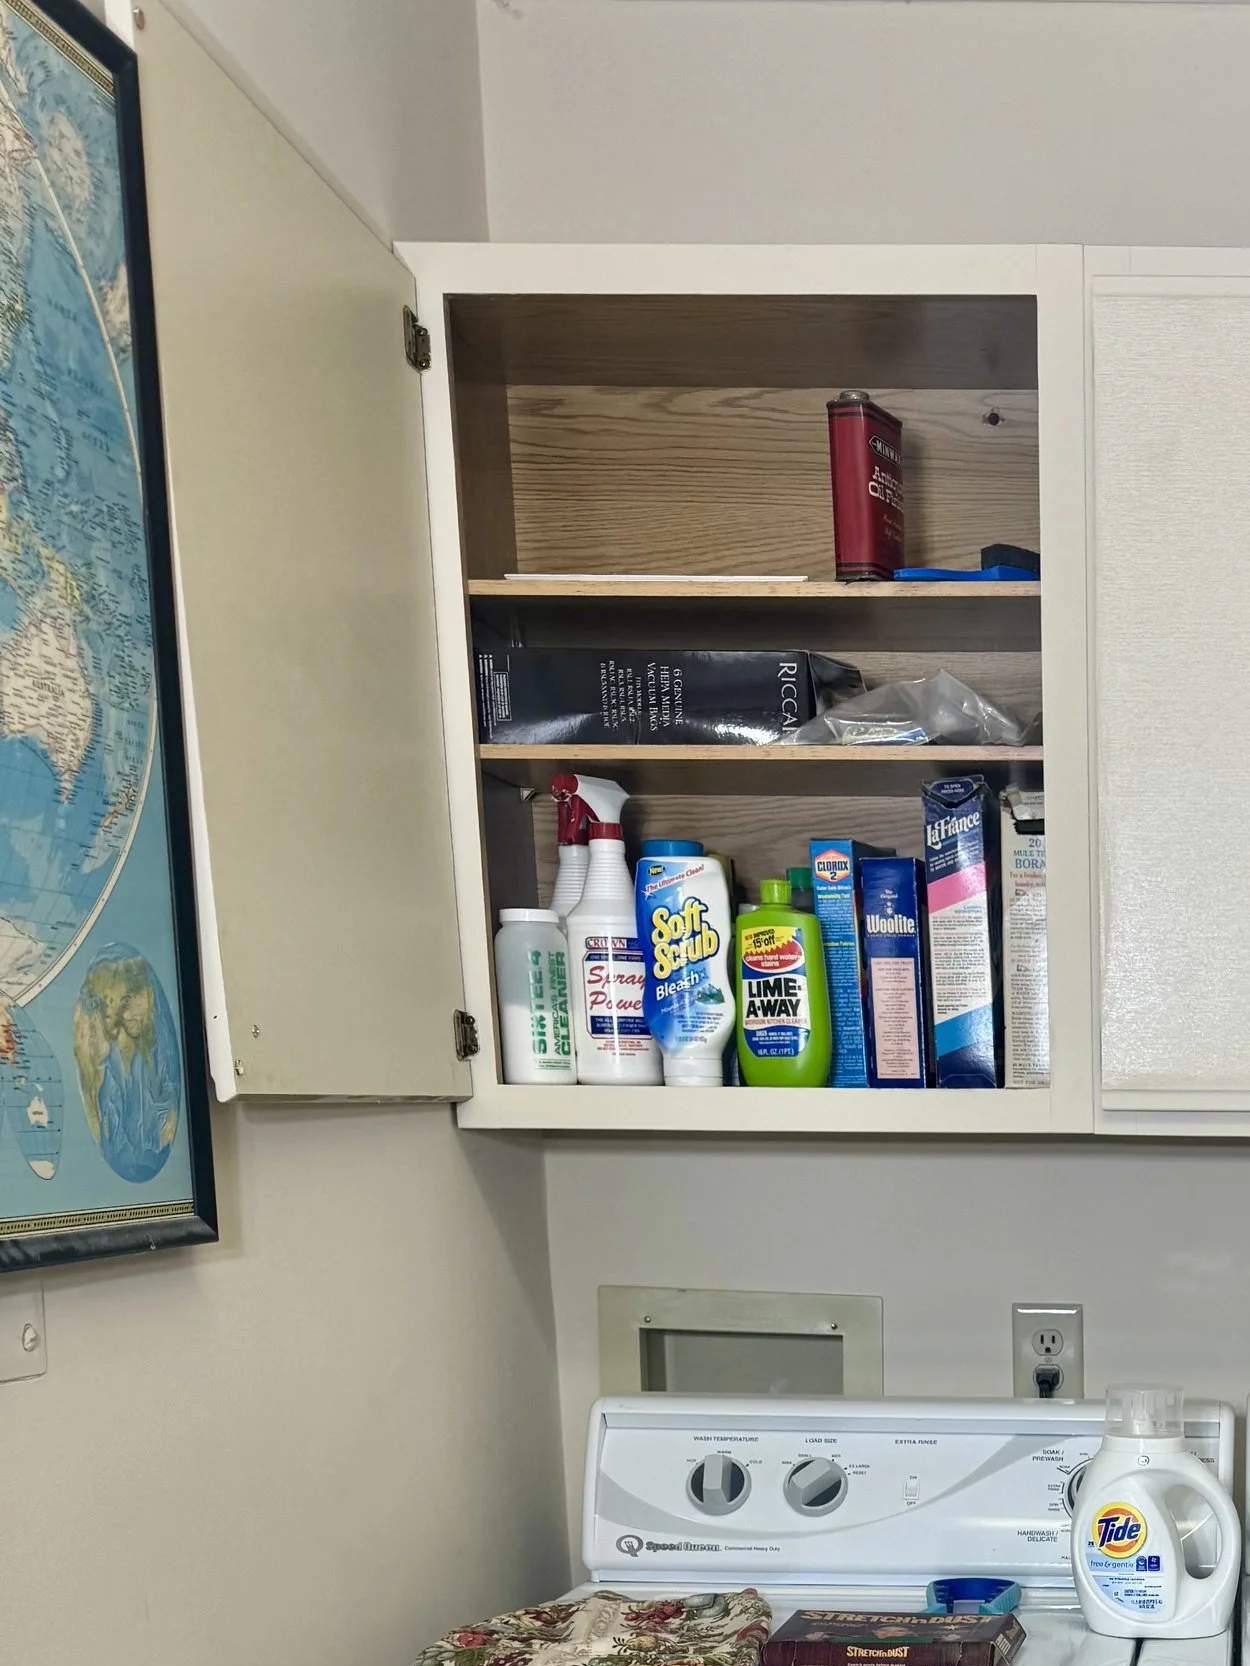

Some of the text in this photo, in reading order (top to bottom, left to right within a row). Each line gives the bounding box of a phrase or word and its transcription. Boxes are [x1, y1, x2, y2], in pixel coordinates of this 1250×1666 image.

[868, 481, 886, 501] Oil
[647, 662, 659, 731] VACUUM BAGS
[660, 666, 671, 727] HEPA MEDIA
[673, 668, 684, 725] 6 GENUINE
[1013, 849, 1035, 857] MULE
[1028, 838, 1042, 848] 20
[817, 861, 849, 872] CLOROX
[1015, 859, 1046, 869] BORA
[646, 864, 705, 893] The Ultimate Clean!
[830, 871, 837, 881] 2
[651, 897, 708, 945] Soft
[865, 914, 916, 934] Woolite
[764, 934, 776, 946] off
[653, 921, 719, 980] Scrub
[587, 965, 645, 990] Spray
[656, 970, 700, 1001] Bleach
[556, 951, 572, 1056] CLEANER
[589, 990, 642, 1011] Powe
[551, 994, 562, 1056] AMERICA'S
[1097, 1516, 1142, 1548] Tide
[646, 1541, 682, 1552] Speed
[1111, 1560, 1134, 1568] gentle
[928, 1615, 995, 1624] DUST
[887, 1646, 910, 1658] DUST
